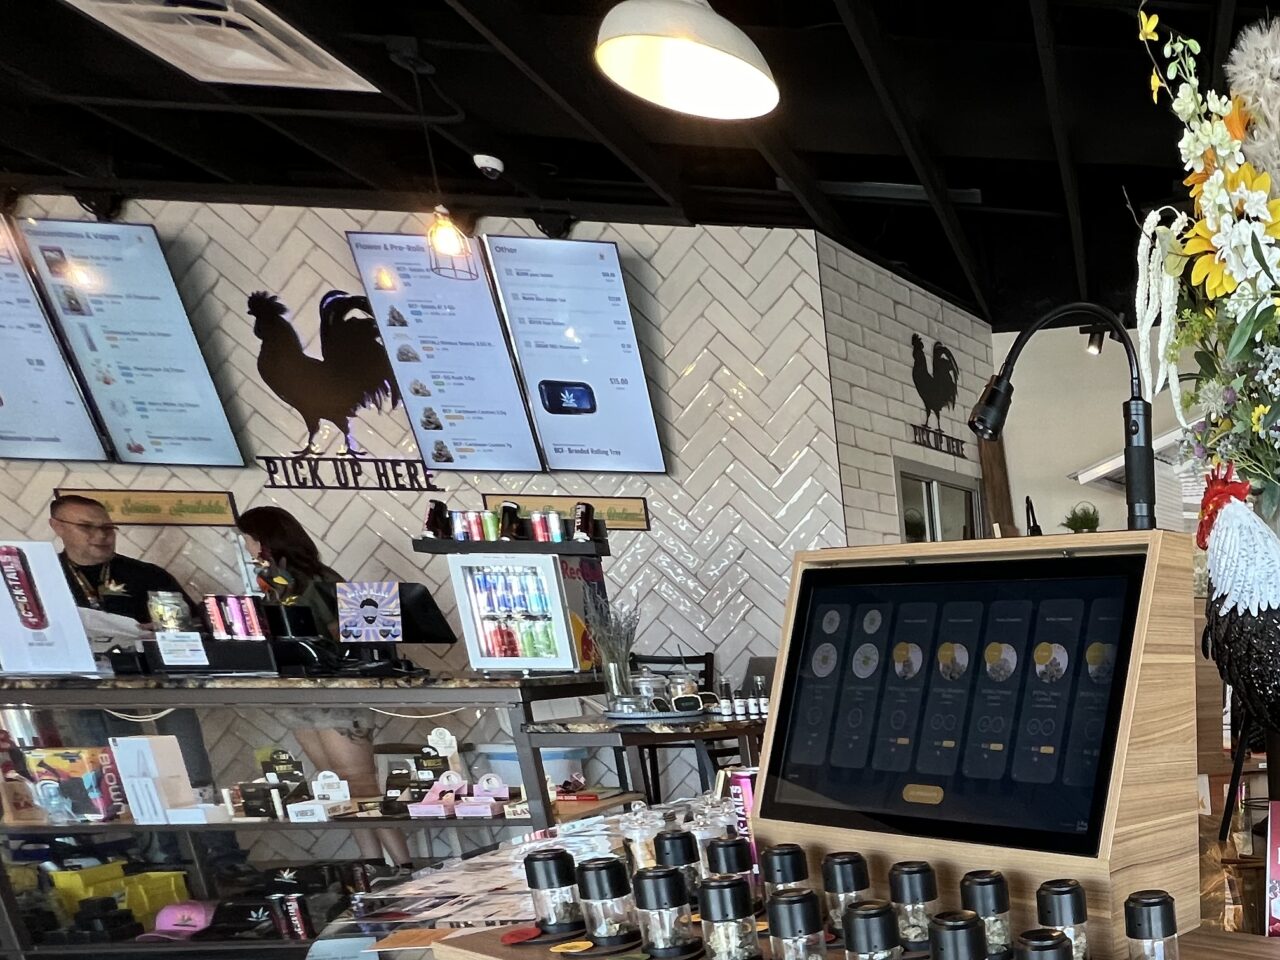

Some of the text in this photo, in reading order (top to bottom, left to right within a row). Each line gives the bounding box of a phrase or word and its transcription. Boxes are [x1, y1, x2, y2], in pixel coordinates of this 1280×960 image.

[495, 245, 517, 254] Other
[266, 459, 437, 490] PICK UP HERE
